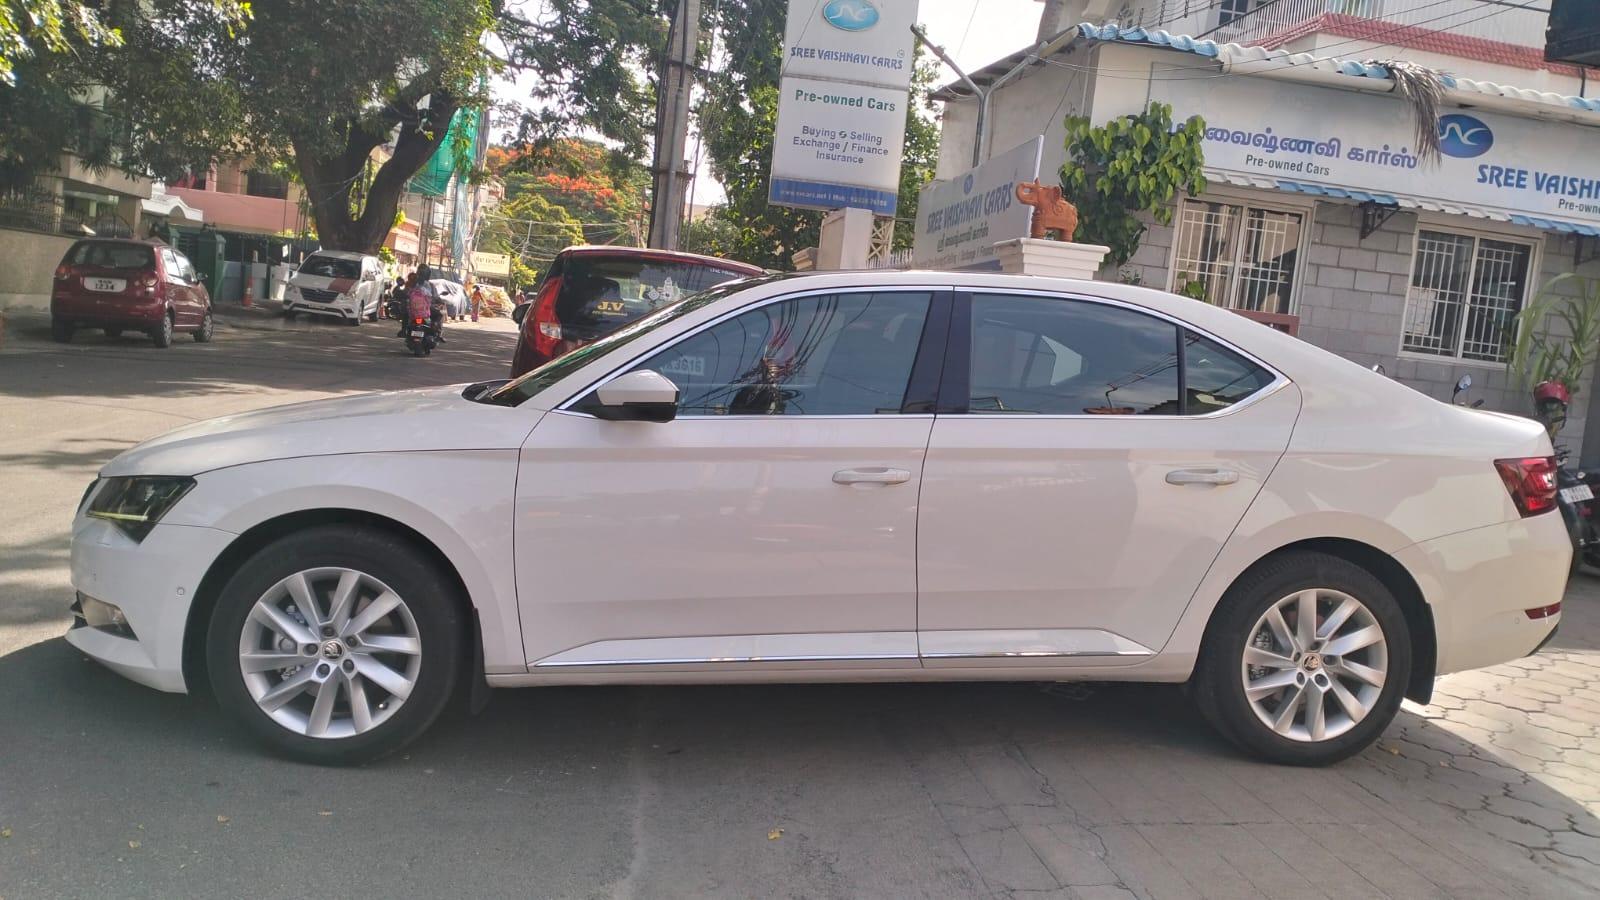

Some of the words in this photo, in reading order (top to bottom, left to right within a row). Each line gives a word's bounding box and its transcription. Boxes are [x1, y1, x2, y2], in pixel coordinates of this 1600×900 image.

[791, 47, 815, 59] SREE
[818, 49, 870, 65] VAISHNAVI
[871, 56, 903, 70] CARRS
[795, 89, 863, 107] Pre-owned
[867, 97, 896, 112] Cars
[793, 136, 841, 151] Exchange
[842, 141, 849, 152] /
[851, 142, 889, 155] Finance
[802, 125, 836, 140] Buying
[850, 131, 882, 145] Selling
[816, 150, 864, 163] Insurance
[1246, 154, 1304, 172] Pre-owned
[1306, 162, 1330, 176] Cars
[1347, 144, 1417, 169] கார்ஸ்
[1477, 164, 1528, 189] SREE
[984, 181, 1014, 217] CARRS
[597, 301, 625, 312] J.V
